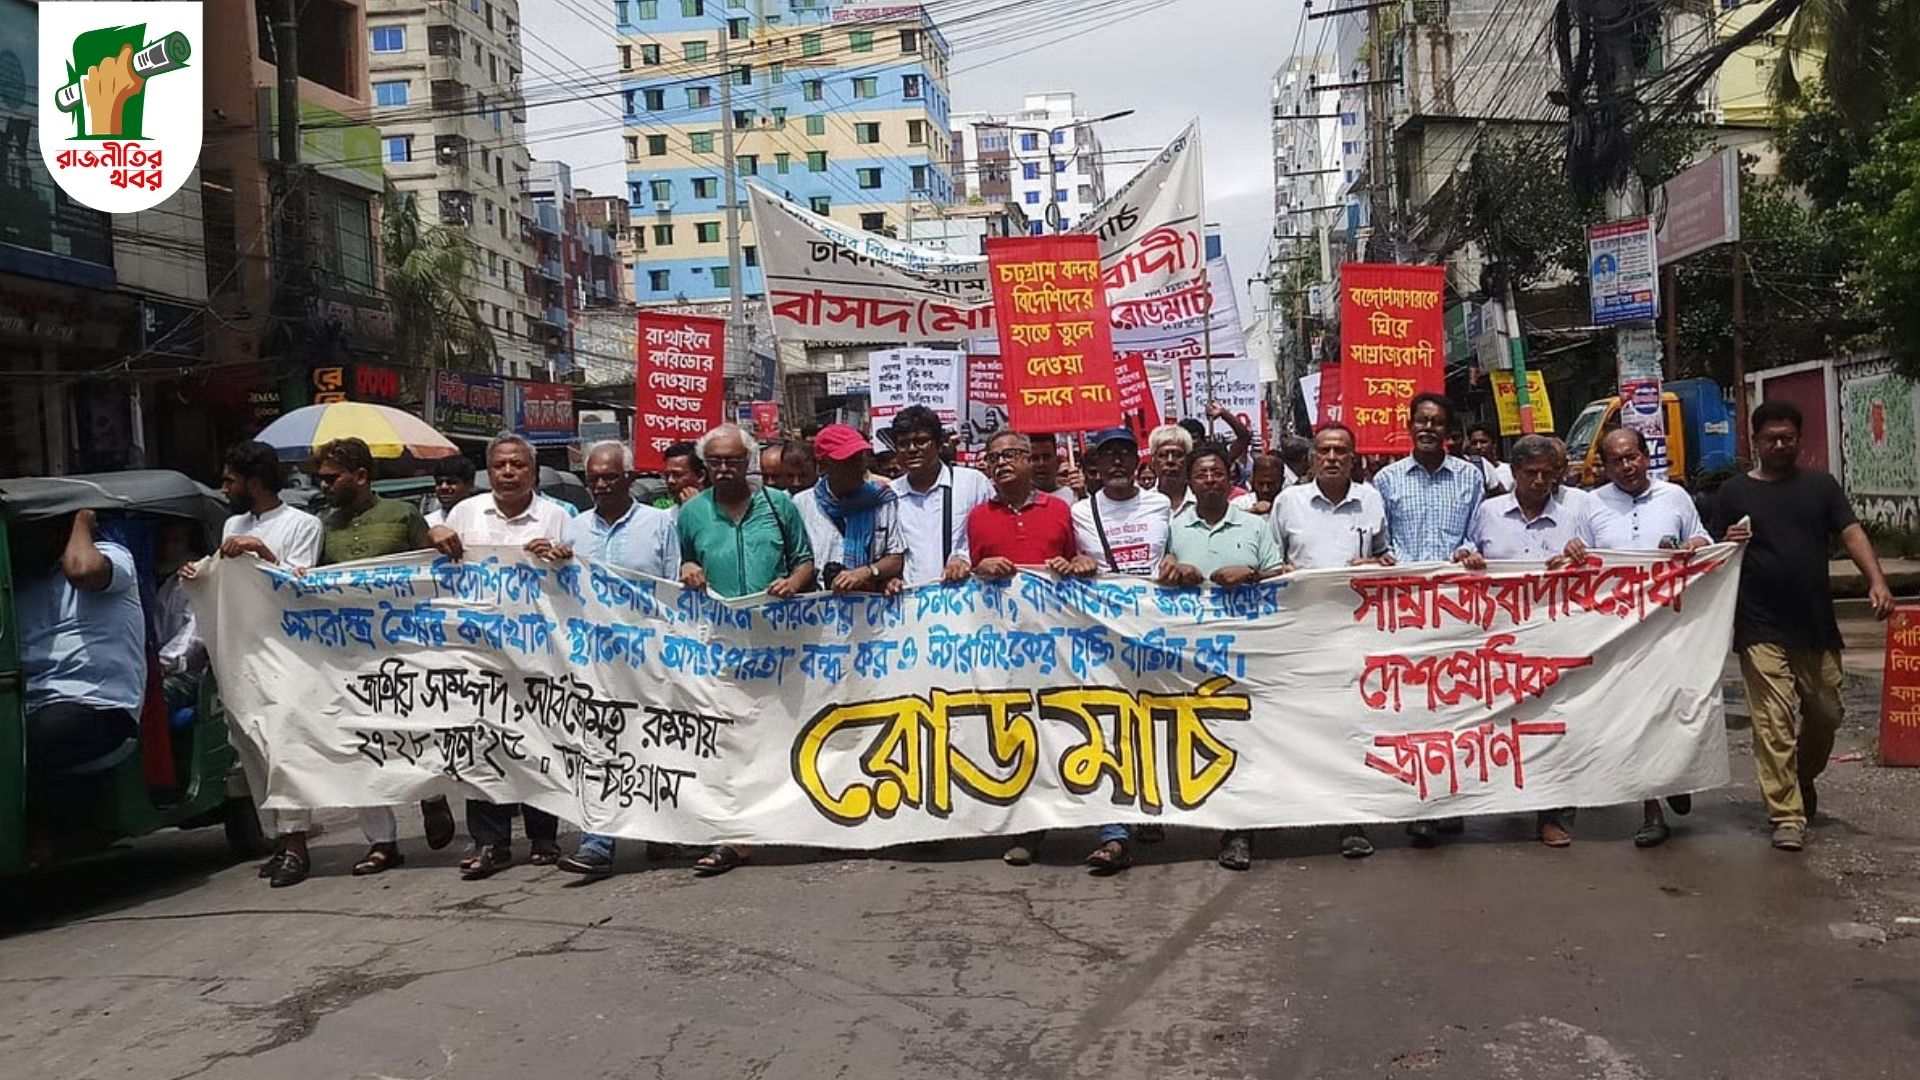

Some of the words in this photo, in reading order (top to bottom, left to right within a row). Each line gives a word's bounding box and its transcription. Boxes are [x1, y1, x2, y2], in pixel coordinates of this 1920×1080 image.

[997, 261, 1056, 286] চট্টগ্রাম
[1060, 260, 1099, 282] বন্দর
[1011, 283, 1094, 314] বিদেশিদের
[1350, 287, 1439, 310] বঙ্গোপসাগরকে
[645, 325, 711, 351] রাখাইনে
[1010, 323, 1051, 346] হাতে
[1056, 321, 1094, 346] তুলে
[1369, 312, 1413, 339] ঘিরে
[648, 347, 714, 373] করিডোর
[1027, 354, 1084, 377] দেওয়া
[1350, 340, 1435, 368] সাম্রাজ্যবাদী
[648, 372, 708, 394] দেওয়ার
[1363, 377, 1417, 398] চক্রান্ত
[656, 394, 703, 412] অশুভ
[1020, 386, 1074, 407] চলবে
[644, 413, 707, 433] তৎপরতা
[1354, 406, 1393, 427] রুখে
[799, 643, 851, 685] বন্ধ
[854, 640, 899, 679] কর
[897, 636, 919, 671] ও
[1359, 634, 1594, 712] দেশপ্রেমিক
[641, 705, 735, 758] রক্ষায়
[356, 730, 431, 767] ২৭-২৮
[791, 687, 1040, 826] রোড
[1037, 676, 1252, 816] মার্চ
[1364, 717, 1567, 800] জনগণ
